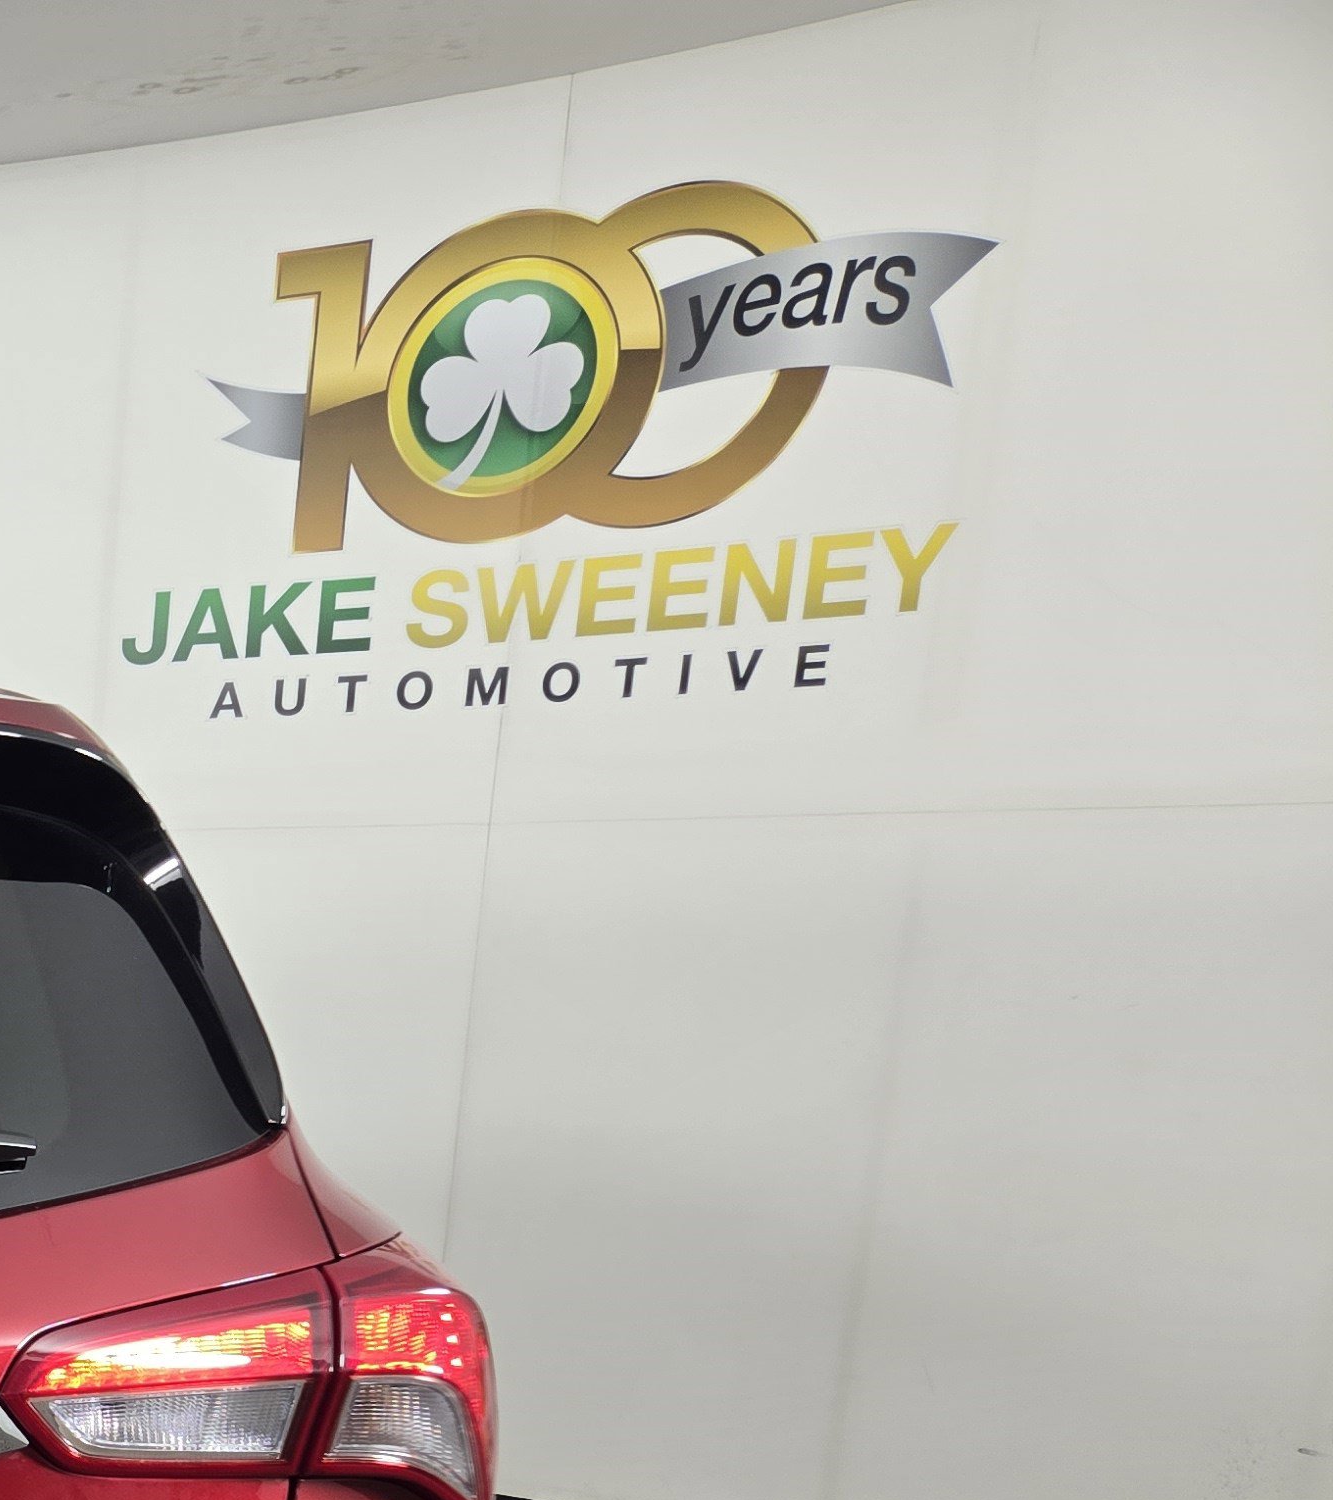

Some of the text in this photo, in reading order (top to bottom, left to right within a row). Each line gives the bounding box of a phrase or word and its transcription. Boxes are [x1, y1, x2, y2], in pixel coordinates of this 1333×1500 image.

[679, 253, 917, 373] years
[121, 522, 960, 666] JAKE SWEENEY
[209, 643, 831, 721] AUTOMOTIVE
